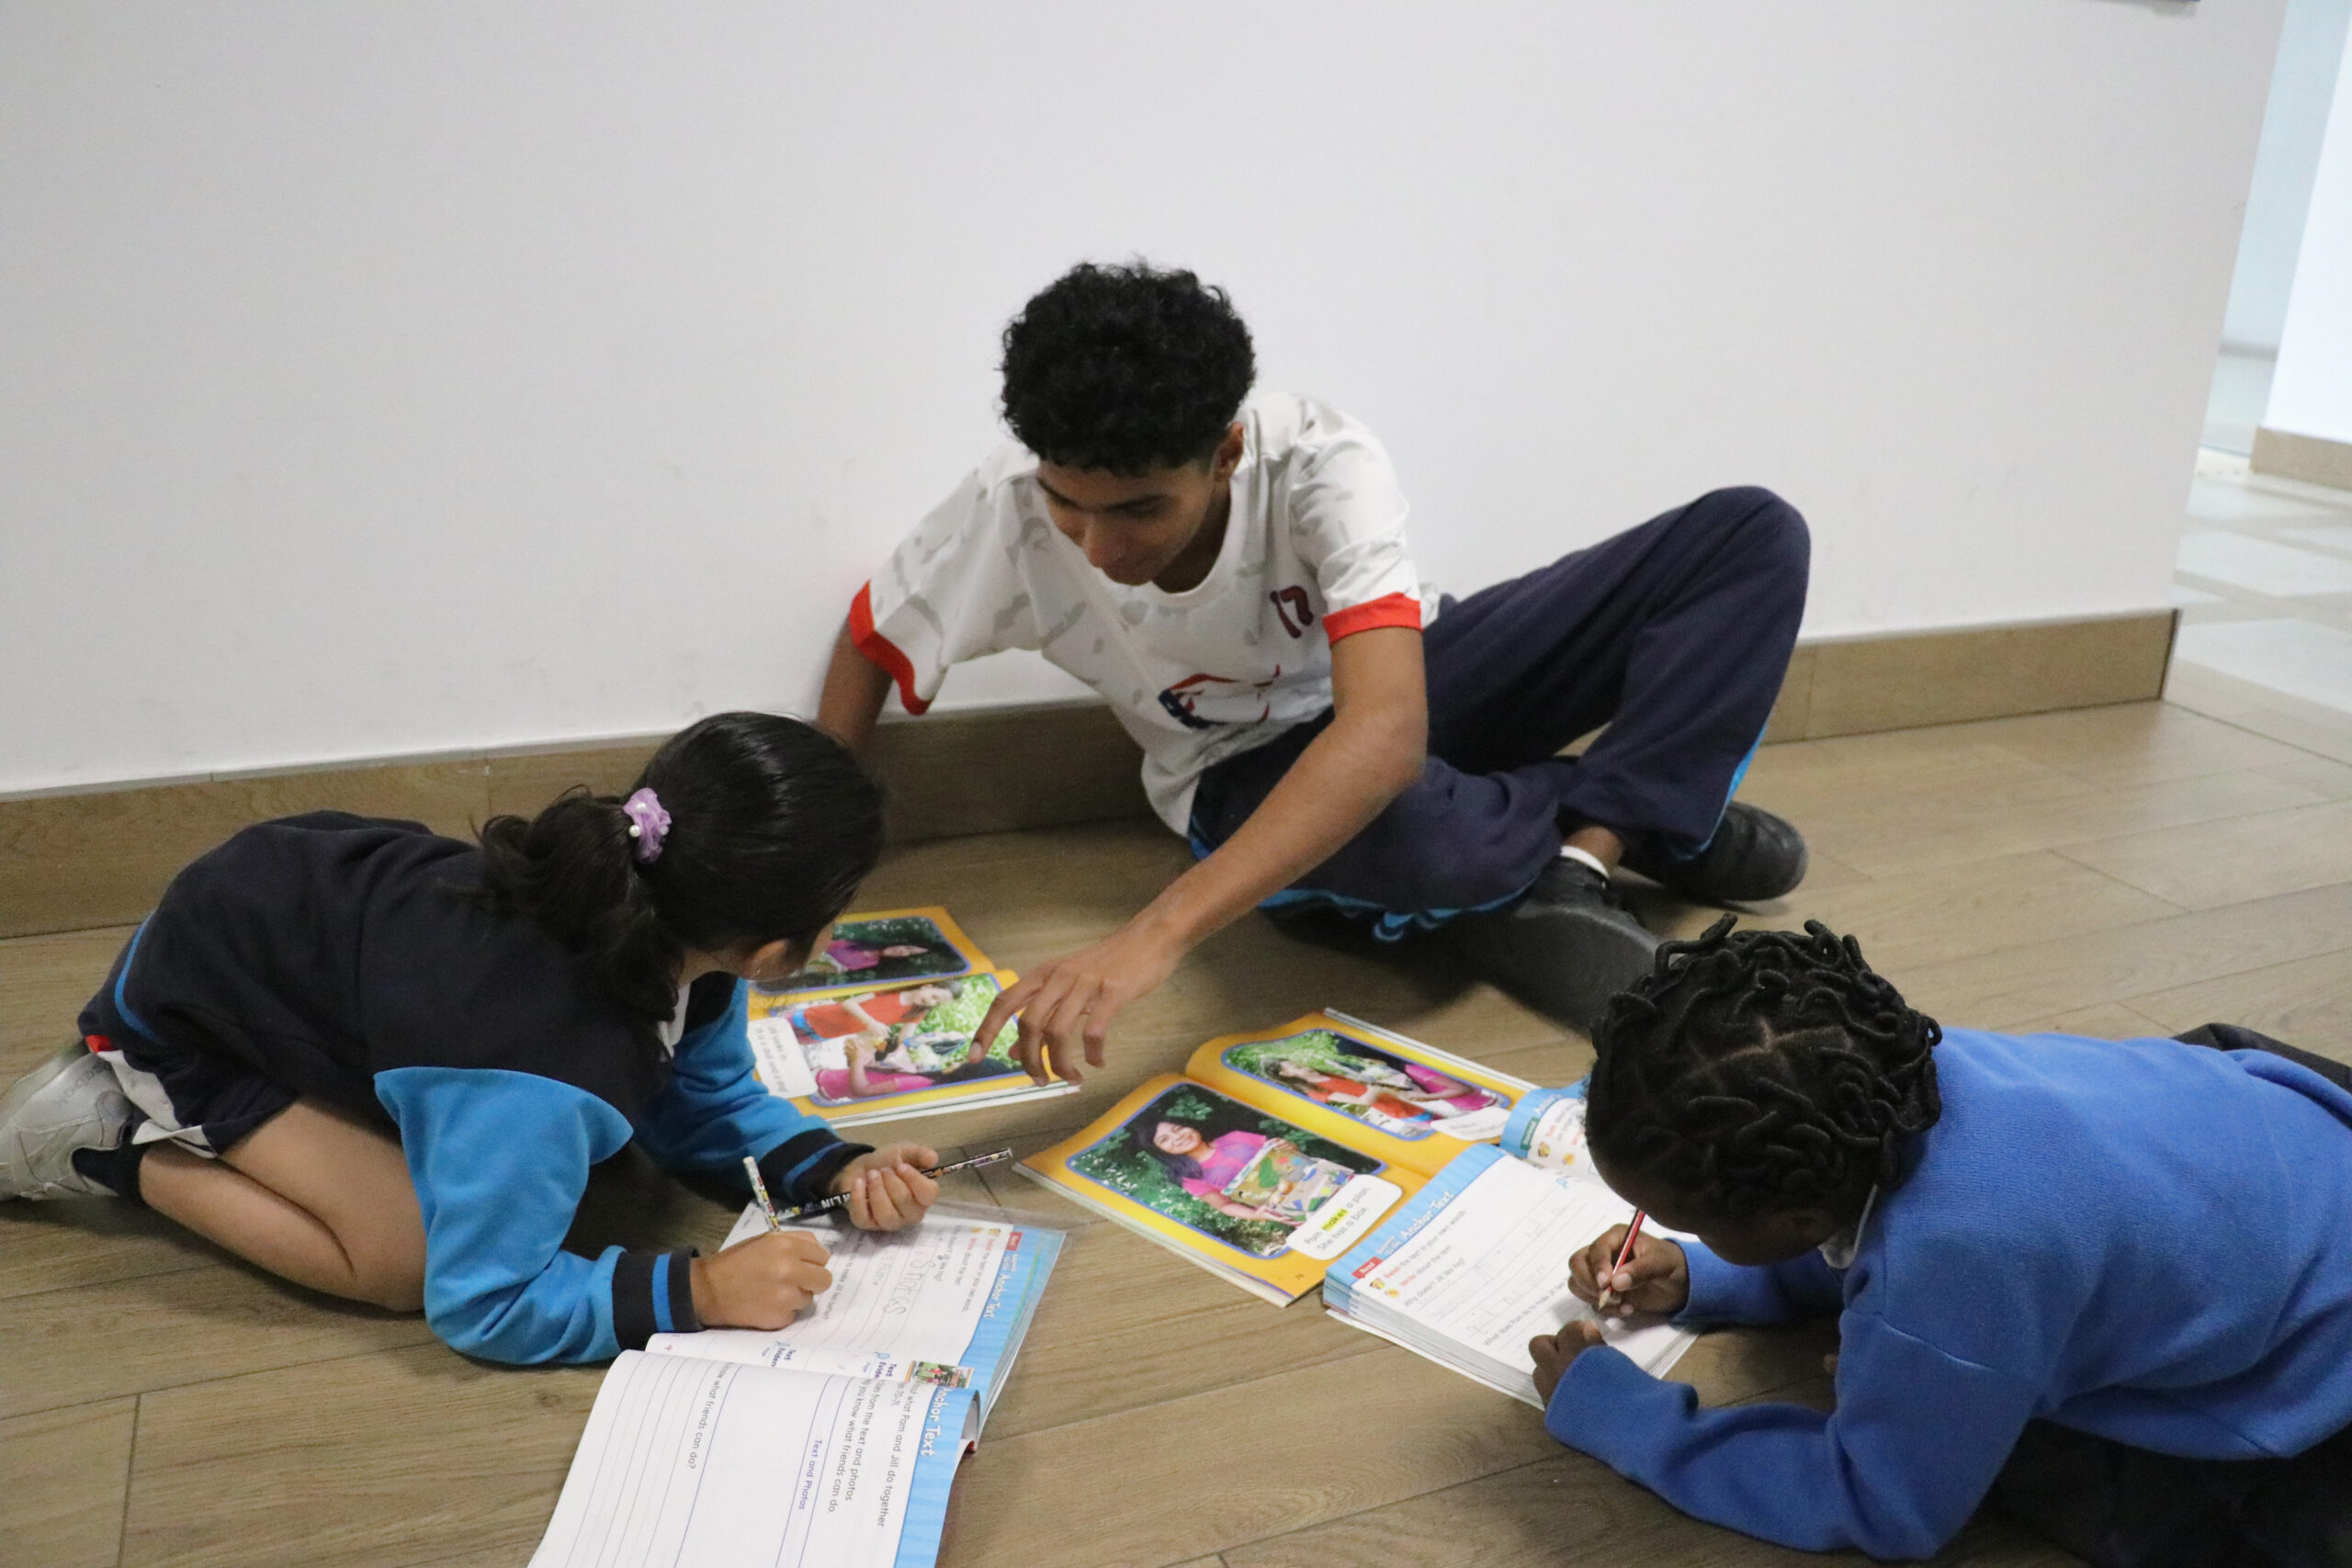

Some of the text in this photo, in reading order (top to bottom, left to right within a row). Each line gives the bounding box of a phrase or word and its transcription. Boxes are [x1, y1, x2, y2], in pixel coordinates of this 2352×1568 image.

[1270, 585, 1314, 639] 17
[1399, 1211, 1435, 1240] Anchor
[1430, 1190, 1455, 1210] Text
[1304, 1231, 1323, 1245] Pam
[1321, 1208, 1348, 1231] makes
[1317, 1238, 1333, 1249] She
[1332, 1226, 1348, 1239] has
[990, 1272, 1011, 1301] Anchor
[983, 1302, 1001, 1319] Text
[886, 1363, 898, 1377] Text
[708, 1380, 720, 1399] what
[857, 1385, 867, 1397] you
[851, 1397, 865, 1417] know
[867, 1393, 881, 1410] from
[902, 1395, 915, 1413] what
[697, 1400, 716, 1430] friends
[863, 1412, 874, 1426] the
[897, 1414, 910, 1433] Pam
[692, 1431, 703, 1450] can
[844, 1420, 856, 1442] what
[858, 1427, 870, 1445] text
[892, 1436, 903, 1453] and
[920, 1426, 941, 1457] Text
[686, 1451, 698, 1470] do?
[836, 1444, 852, 1476] friends
[852, 1448, 863, 1466] and
[889, 1454, 900, 1468] Jill
[797, 1438, 823, 1510] Text and Photos
[886, 1470, 897, 1483] do
[831, 1478, 842, 1496] can
[844, 1468, 859, 1501] photos
[877, 1483, 894, 1528] together
